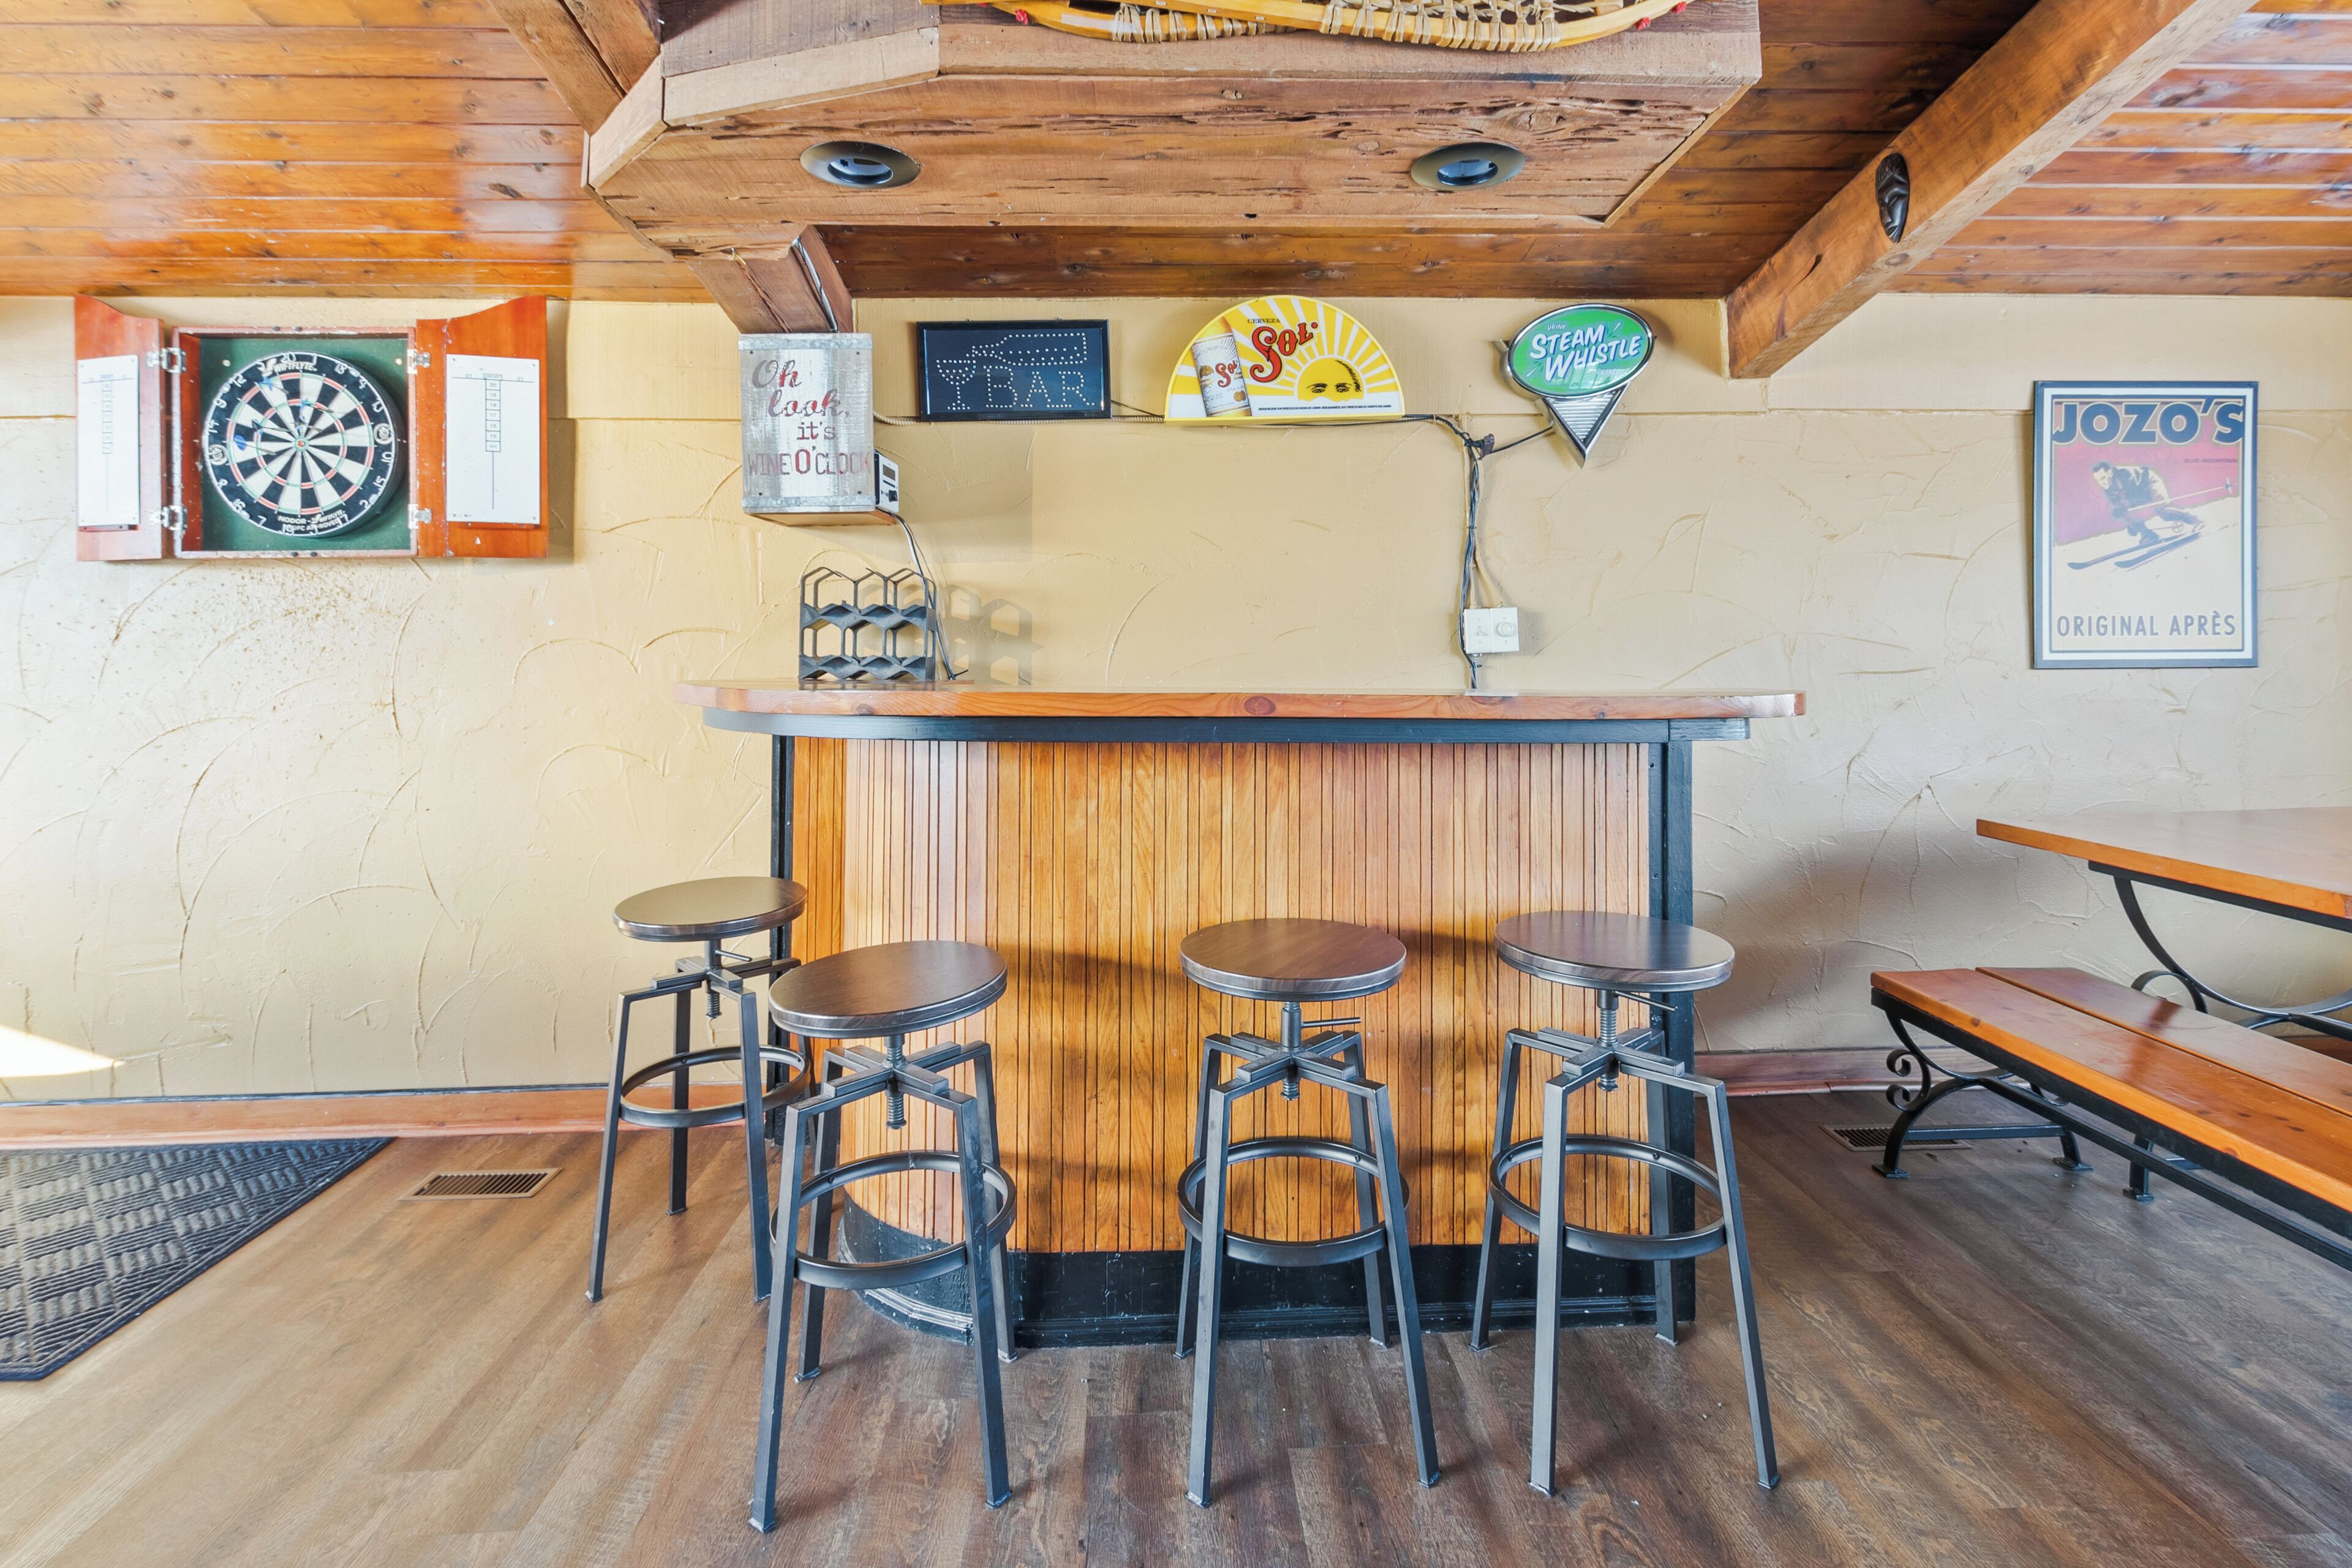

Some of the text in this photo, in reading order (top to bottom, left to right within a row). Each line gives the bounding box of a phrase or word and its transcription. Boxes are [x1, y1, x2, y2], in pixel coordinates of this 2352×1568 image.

[1529, 324, 1605, 360] STEAM
[280, 352, 297, 363] 20
[334, 361, 348, 375] 18
[1545, 335, 1643, 382] WHISTLE
[358, 379, 368, 390] 4
[752, 360, 802, 388] Oh
[983, 365, 1095, 409] BAR
[797, 421, 835, 440] it's
[2052, 400, 2244, 445] JOZO'S
[748, 445, 871, 476] WINE O'CLOCK
[277, 515, 307, 525] NODOR
[2057, 609, 2236, 637] ORIGINAL APRÈS
